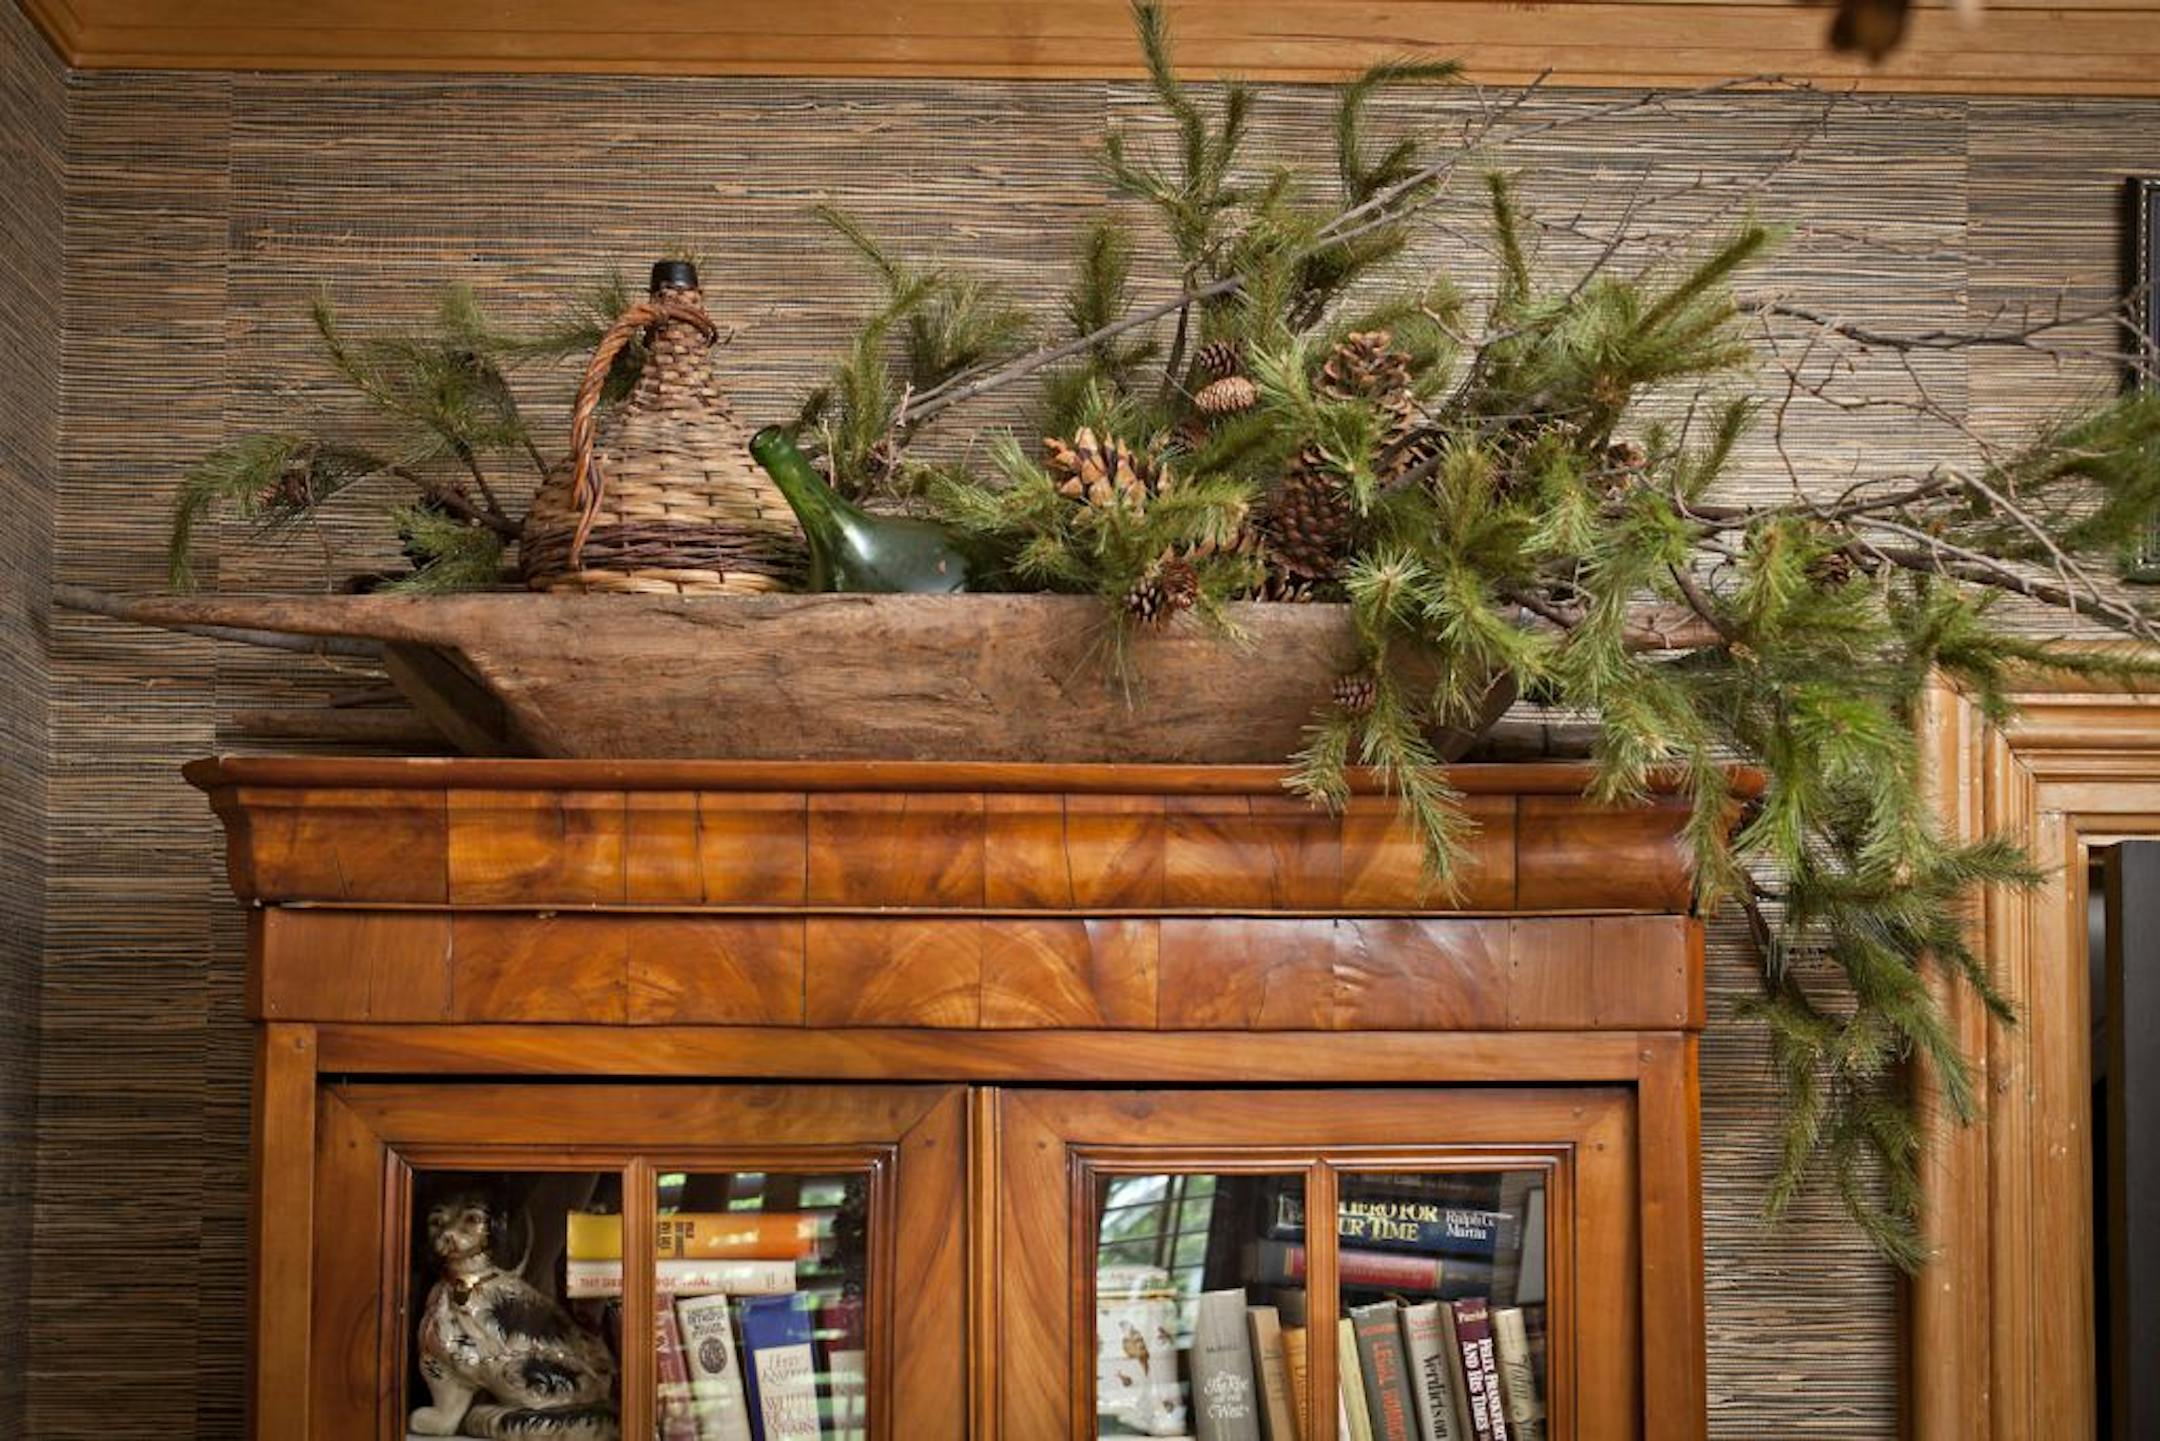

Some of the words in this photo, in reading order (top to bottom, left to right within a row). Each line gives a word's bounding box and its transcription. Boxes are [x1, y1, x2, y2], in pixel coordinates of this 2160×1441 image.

[1399, 1203, 1438, 1223] FOR
[1366, 1217, 1419, 1242] TIME
[1446, 1224, 1486, 1240] Martin
[1462, 1340, 1480, 1370] AND
[1478, 1337, 1496, 1374] FELIX
[1424, 1353, 1446, 1419] Verdicts
[1467, 1369, 1484, 1394] HIS
[1472, 1392, 1490, 1432] TIMES
